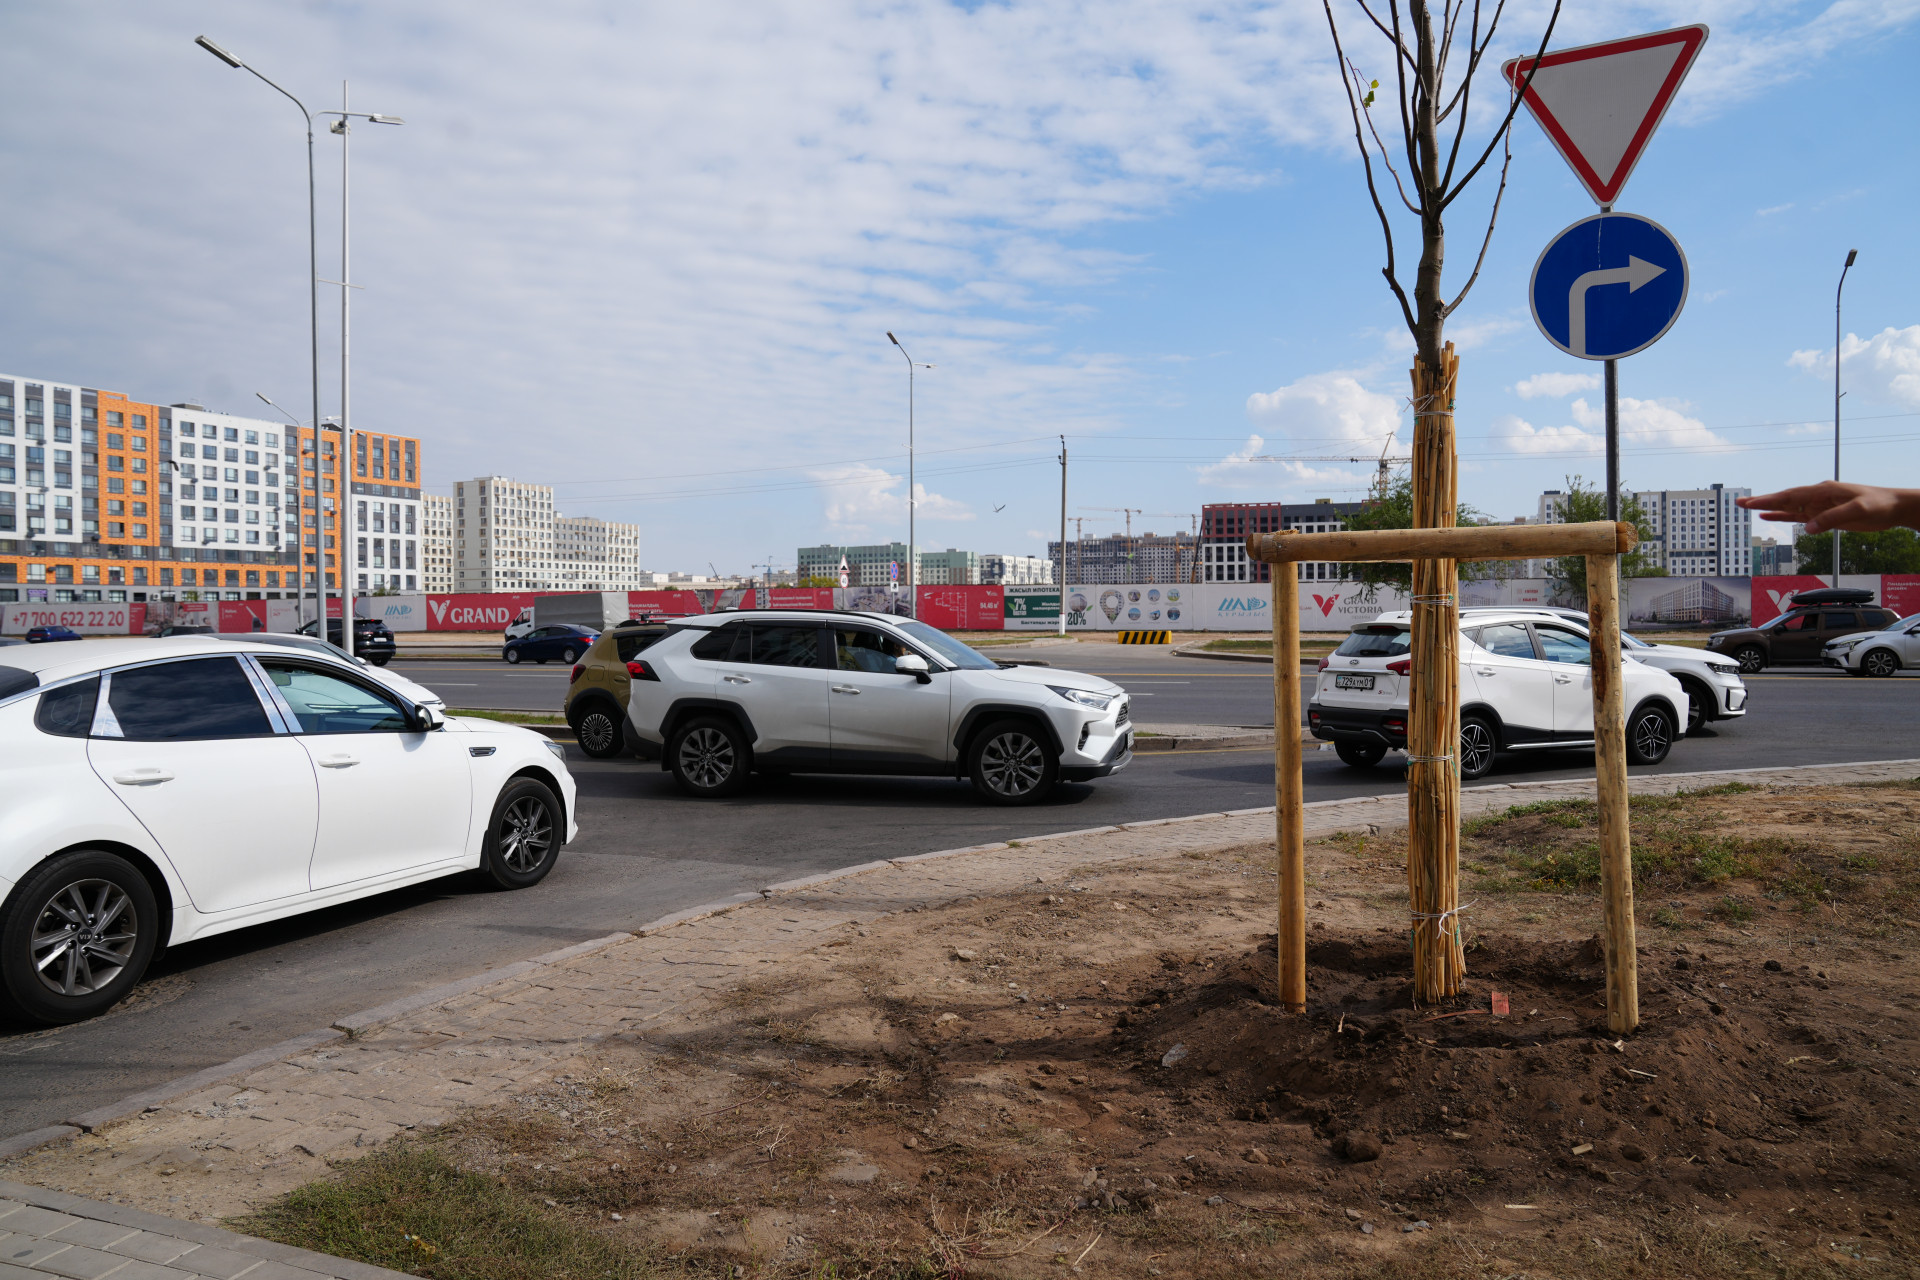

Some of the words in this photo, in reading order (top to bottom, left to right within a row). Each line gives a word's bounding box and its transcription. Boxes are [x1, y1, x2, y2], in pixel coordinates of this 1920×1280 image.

[1343, 597, 1378, 605] GRAND
[450, 607, 510, 624] GRAND
[1338, 606, 1384, 614] VICTORIA
[13, 612, 28, 627] +7
[31, 612, 57, 626] 700
[60, 611, 84, 627] 622
[88, 611, 104, 627] 22
[107, 610, 124, 627] 20
[1067, 612, 1087, 626] 20%
